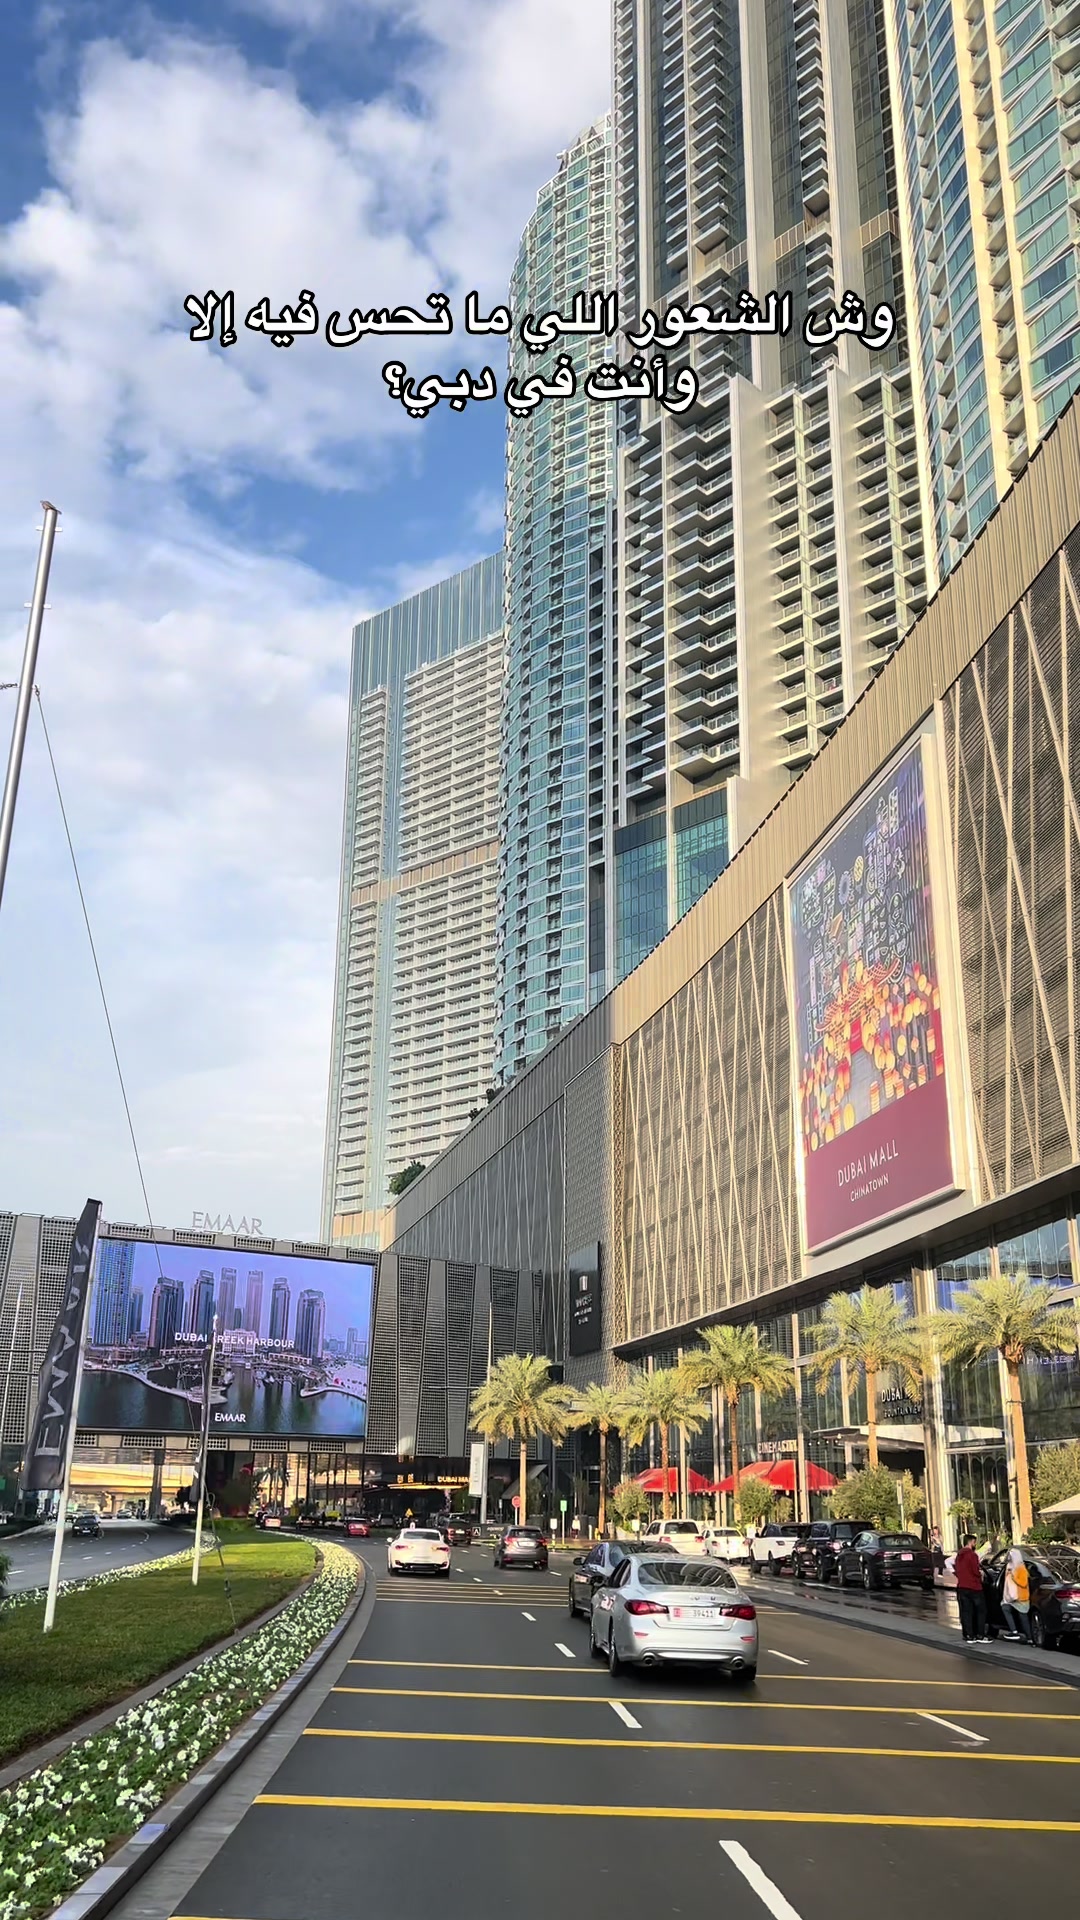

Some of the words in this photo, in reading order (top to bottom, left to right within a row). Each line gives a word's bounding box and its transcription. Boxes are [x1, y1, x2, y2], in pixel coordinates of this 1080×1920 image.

[838, 1155, 867, 1187] DUBAI
[869, 1139, 899, 1170] MALL
[850, 1173, 889, 1202] CHINATOWN
[192, 1211, 263, 1235] EMAAR
[174, 1332, 208, 1343] DUBAI
[246, 1336, 295, 1349] HARBOUR
[882, 1387, 903, 1402] DUBAI
[214, 1413, 246, 1423] EMAAR
